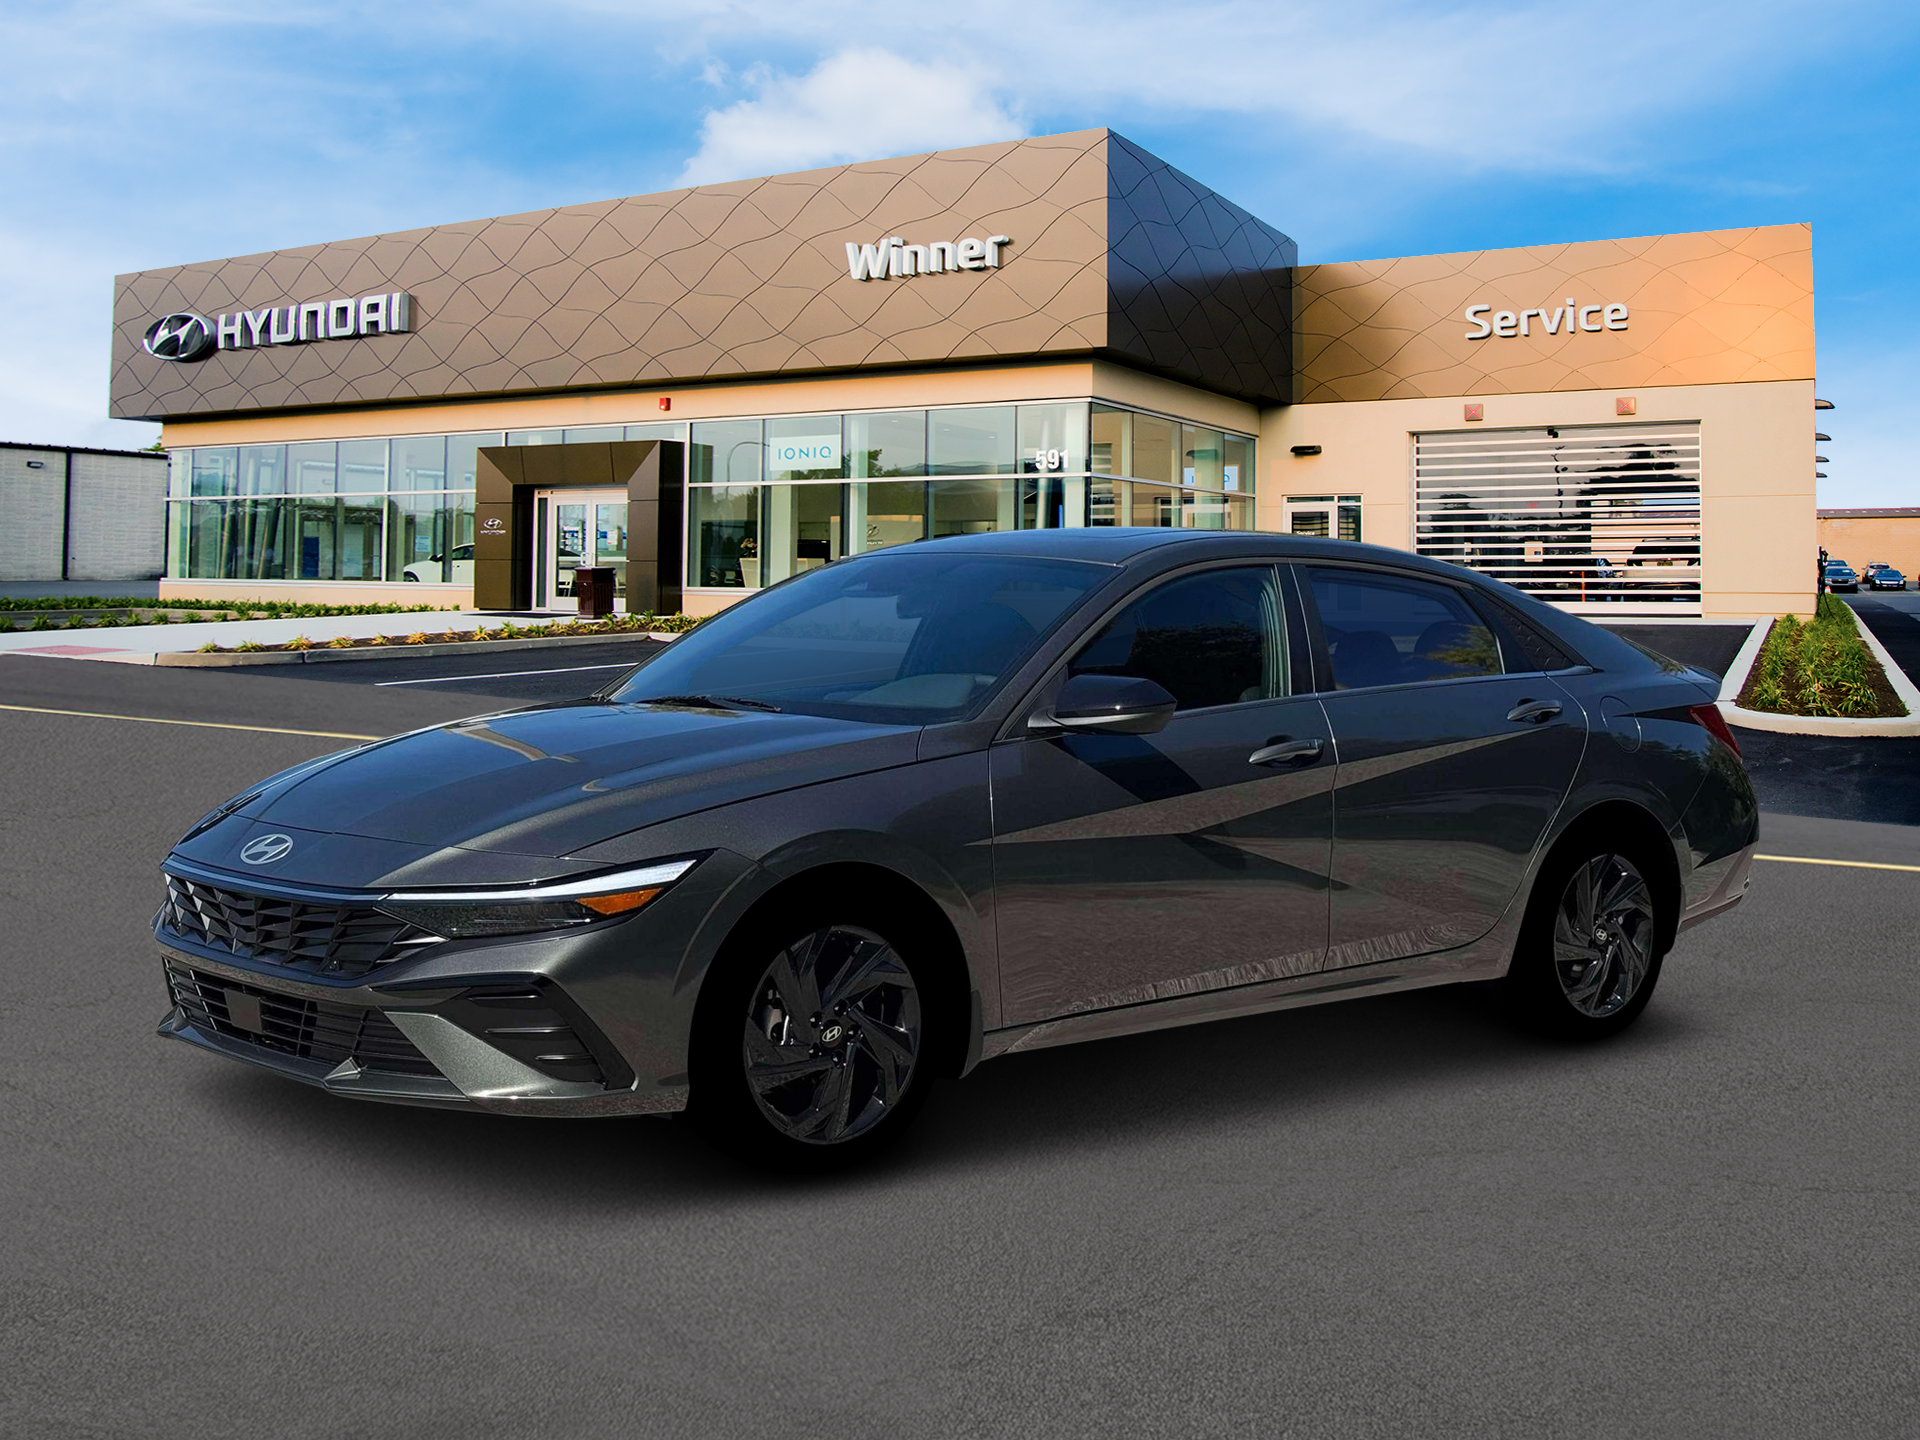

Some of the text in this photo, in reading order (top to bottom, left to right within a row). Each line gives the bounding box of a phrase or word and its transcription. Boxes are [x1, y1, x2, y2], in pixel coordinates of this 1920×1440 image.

[845, 235, 1010, 281] Winner
[217, 292, 408, 349] HYUNDAI
[1465, 297, 1629, 340] Service
[778, 446, 831, 460] IONIQ
[1035, 449, 1069, 470] 591
